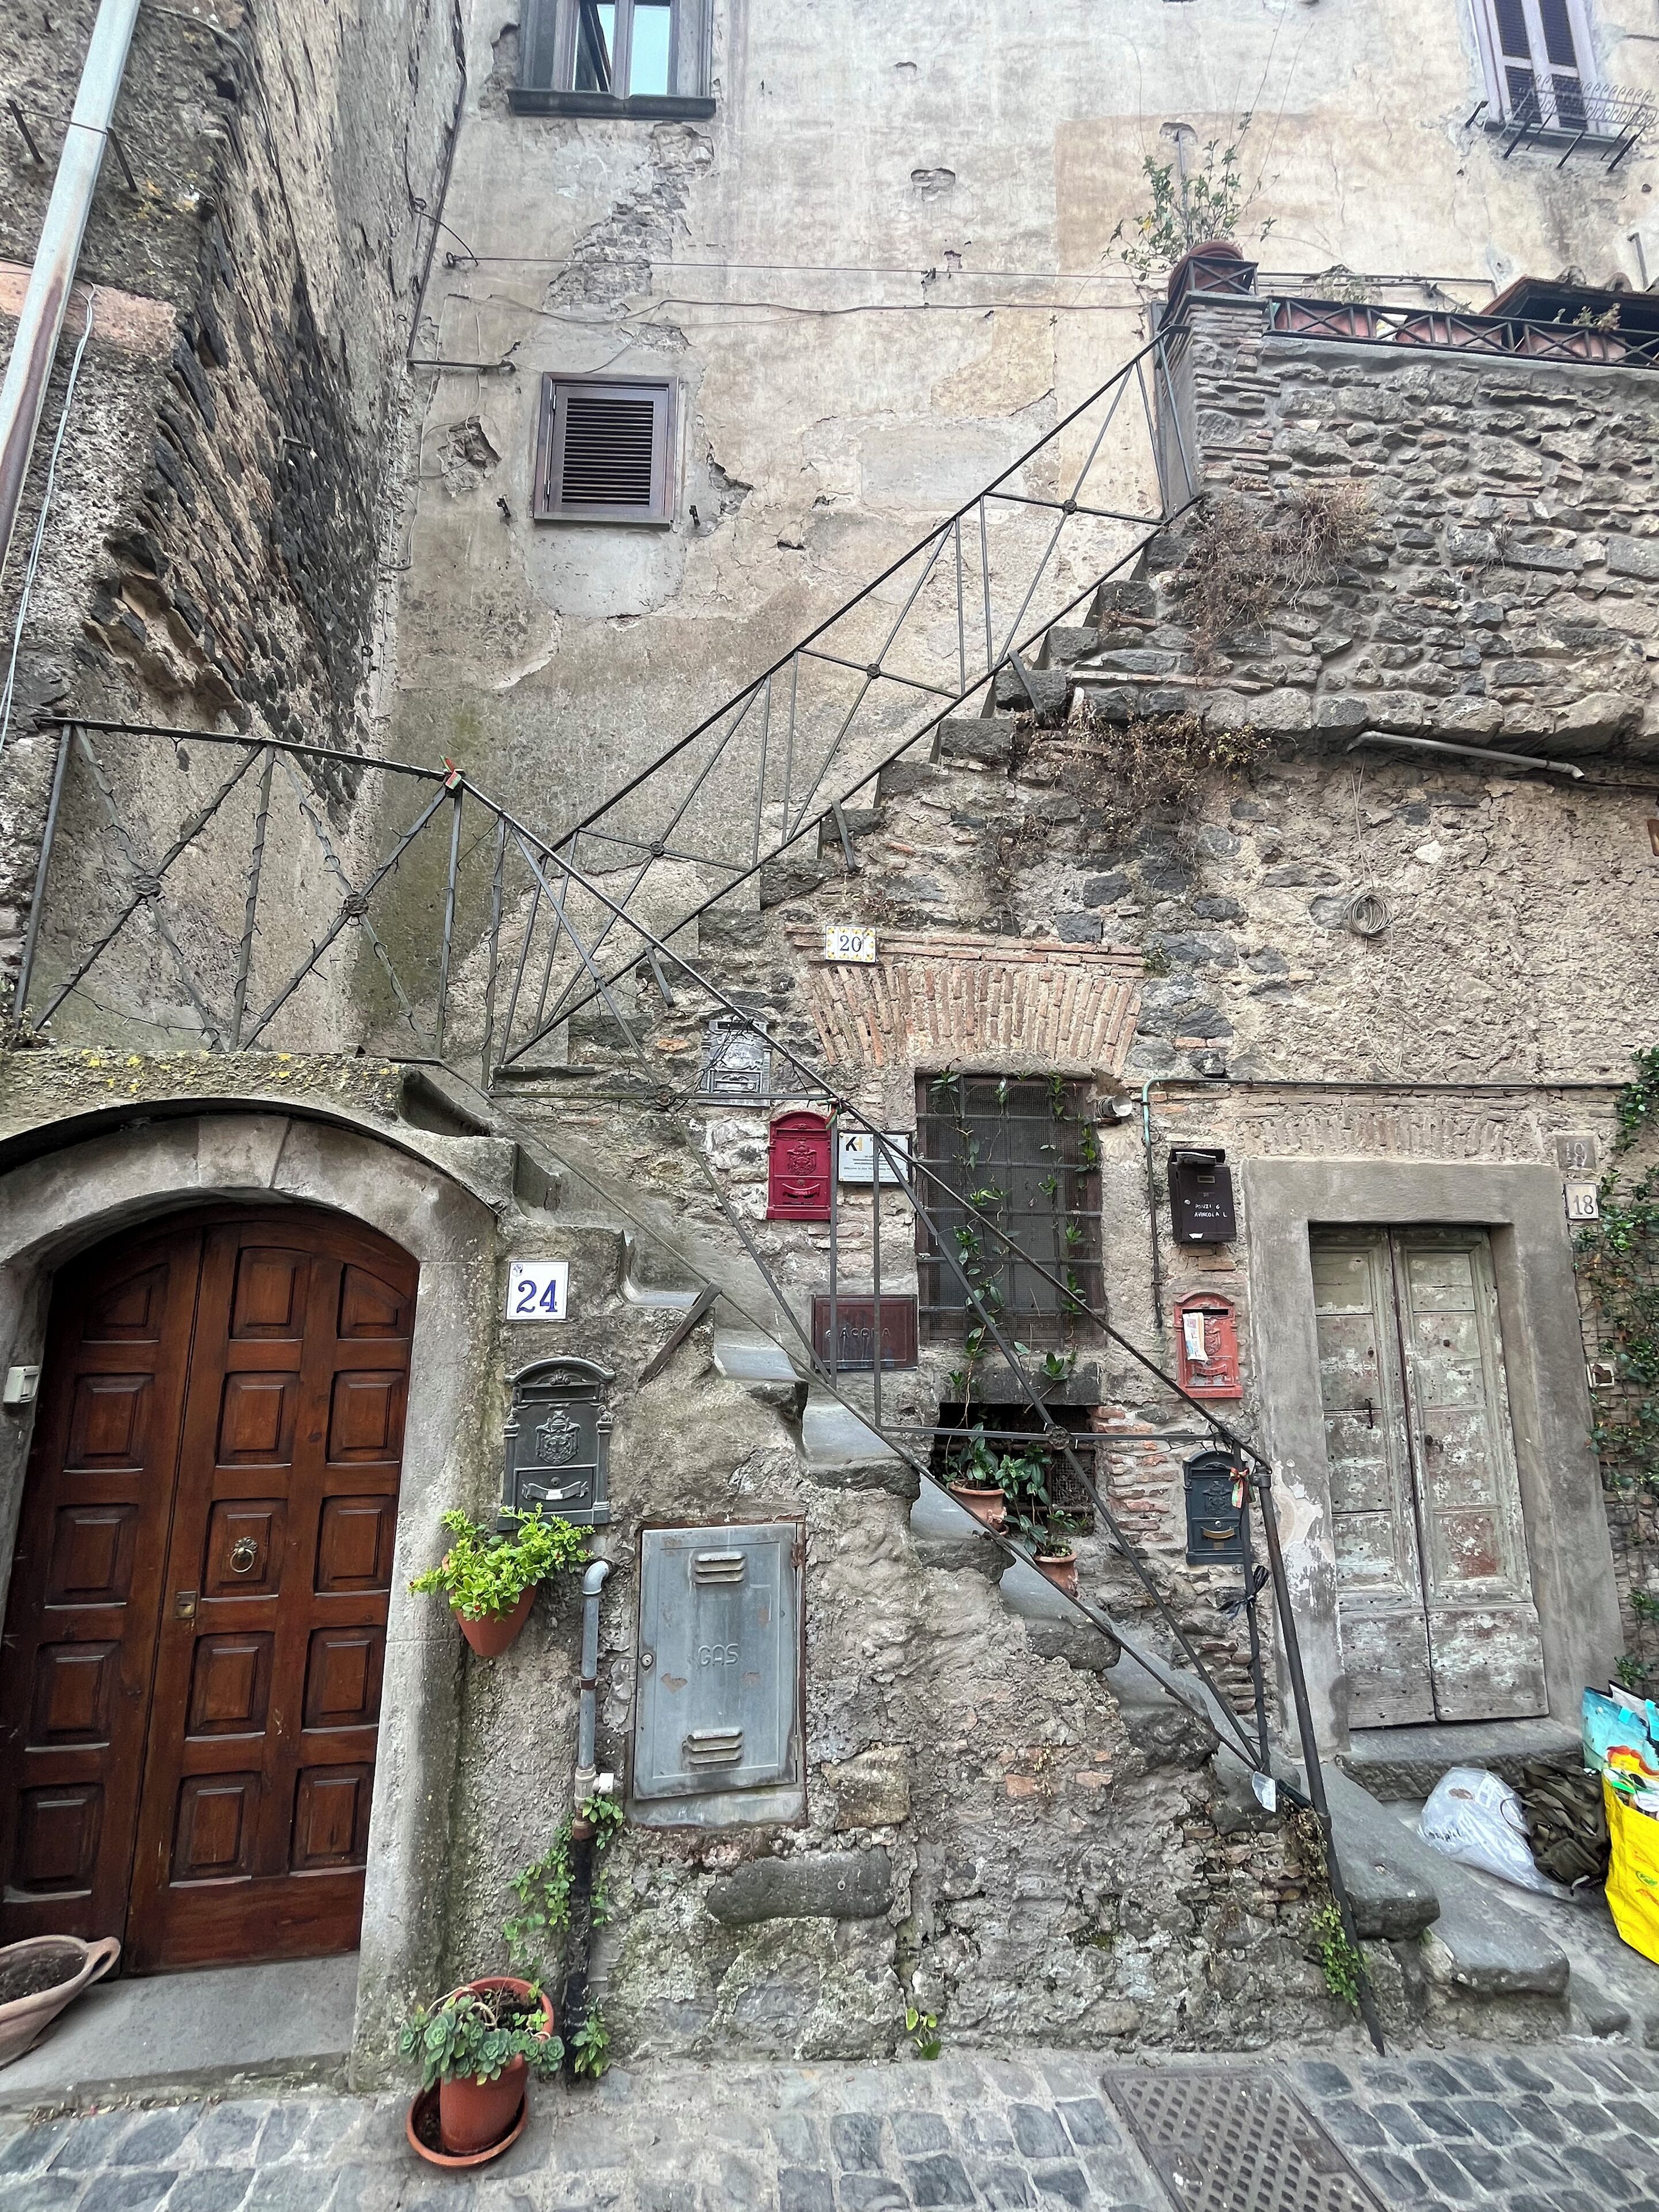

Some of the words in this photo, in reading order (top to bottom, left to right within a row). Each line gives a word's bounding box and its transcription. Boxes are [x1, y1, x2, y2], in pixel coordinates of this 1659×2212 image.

[839, 935, 862, 952] 20
[1573, 1194, 1594, 1215] 18
[516, 1279, 558, 1313] 24
[698, 1643, 738, 1666] GAS
